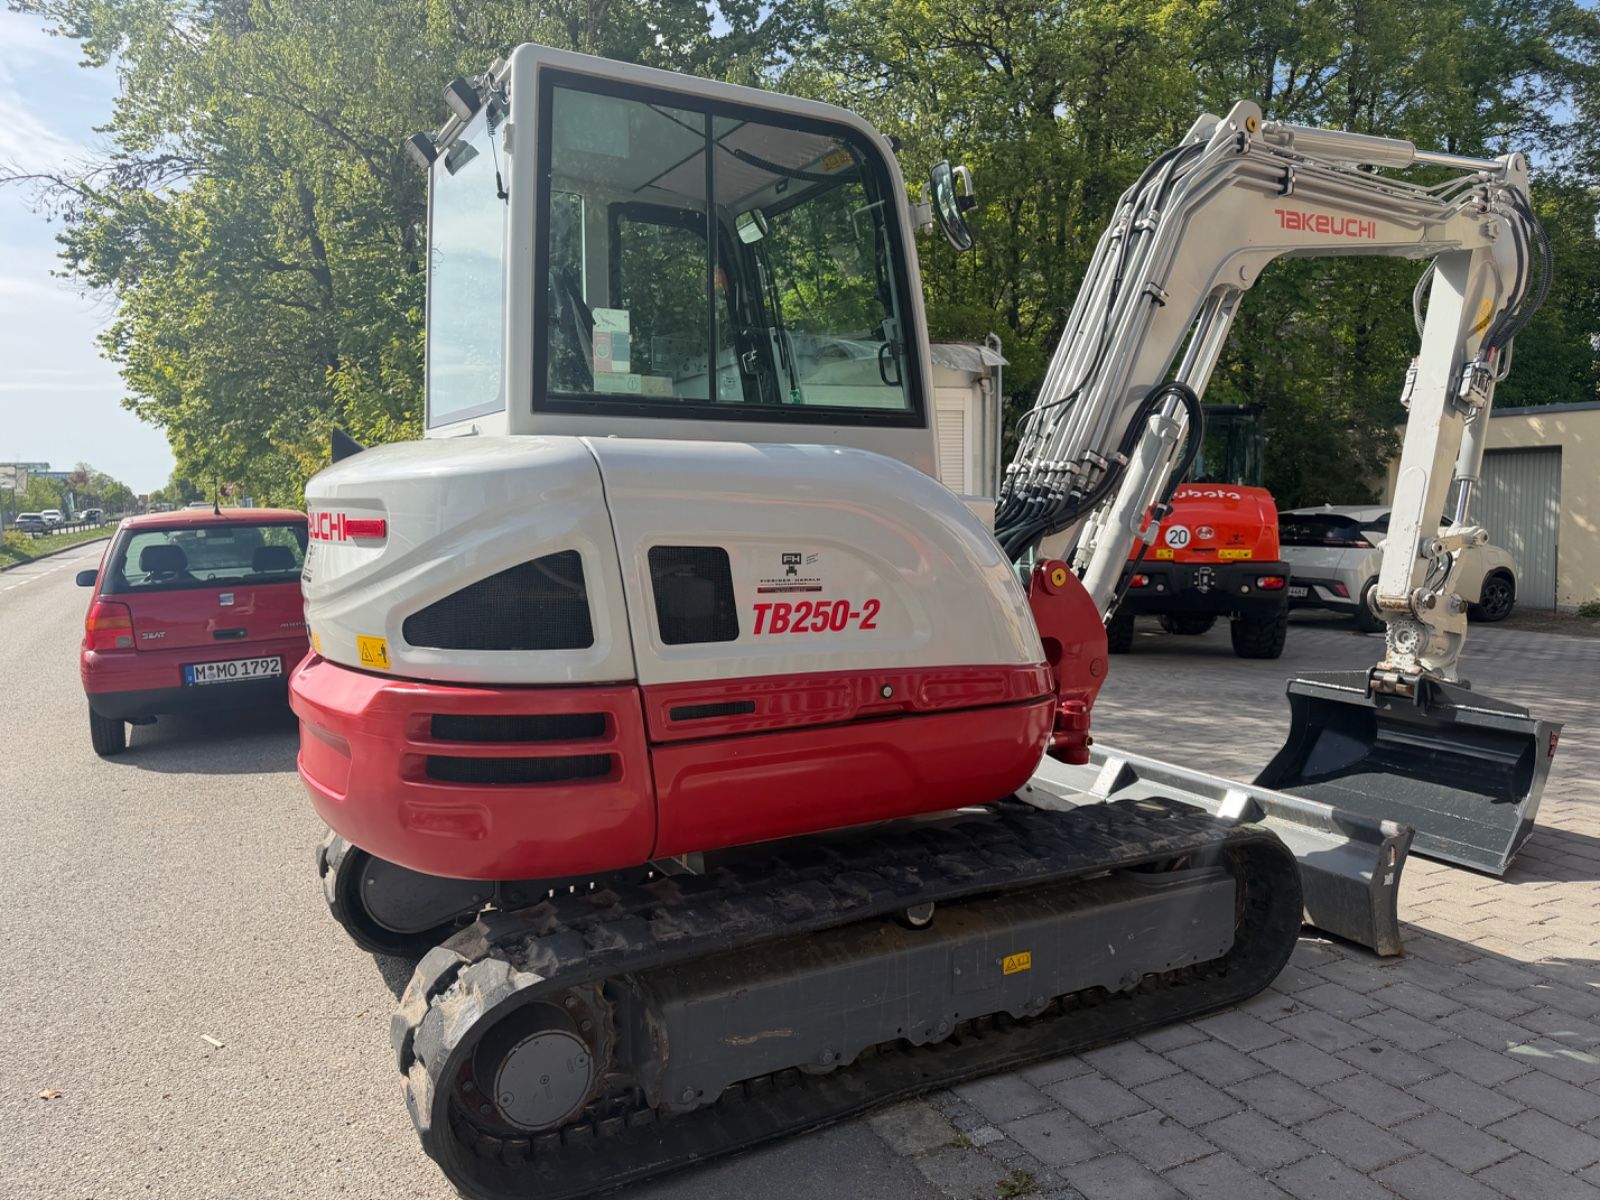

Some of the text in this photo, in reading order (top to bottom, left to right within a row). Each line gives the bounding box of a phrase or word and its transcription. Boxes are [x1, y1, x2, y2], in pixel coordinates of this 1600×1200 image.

[1274, 209, 1376, 239] TAKEUCHI
[1173, 489, 1241, 500] ubota
[1169, 529, 1188, 545] 20
[753, 599, 881, 635] TB250-2
[241, 659, 280, 676] 1792
